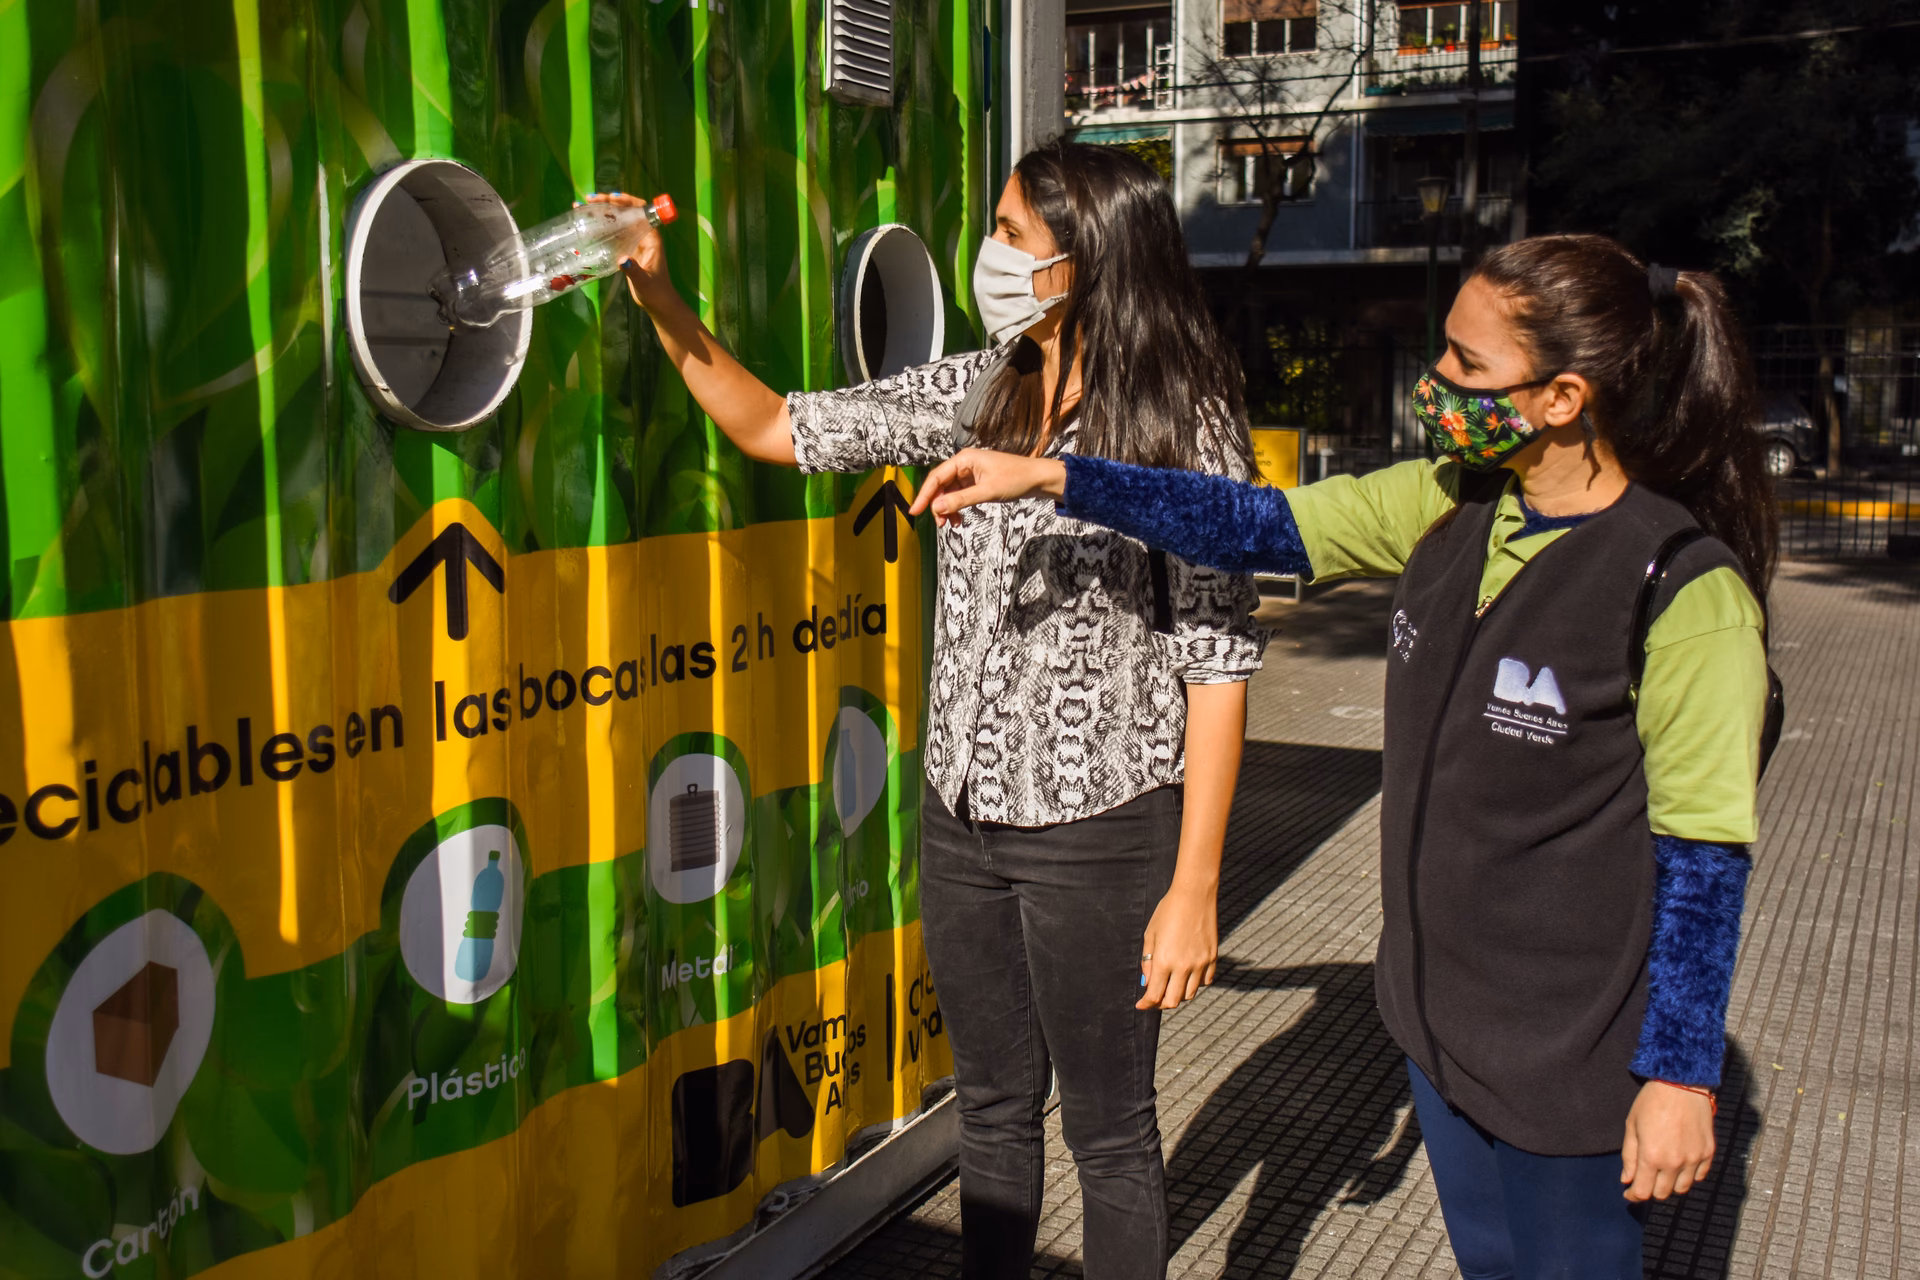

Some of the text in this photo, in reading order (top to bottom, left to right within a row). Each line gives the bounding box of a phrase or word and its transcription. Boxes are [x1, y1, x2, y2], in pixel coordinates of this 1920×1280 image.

[346, 704, 405, 759] en
[434, 680, 512, 742] las
[650, 633, 717, 687] las
[757, 611, 775, 661] h
[840, 593, 887, 642] día
[1486, 702, 1568, 729] Vamos Buenos Aires
[1491, 721, 1555, 745] Ciudad Verde
[661, 944, 733, 992] Metal
[407, 1046, 526, 1112] Plástico
[82, 1186, 200, 1280] Cartón
